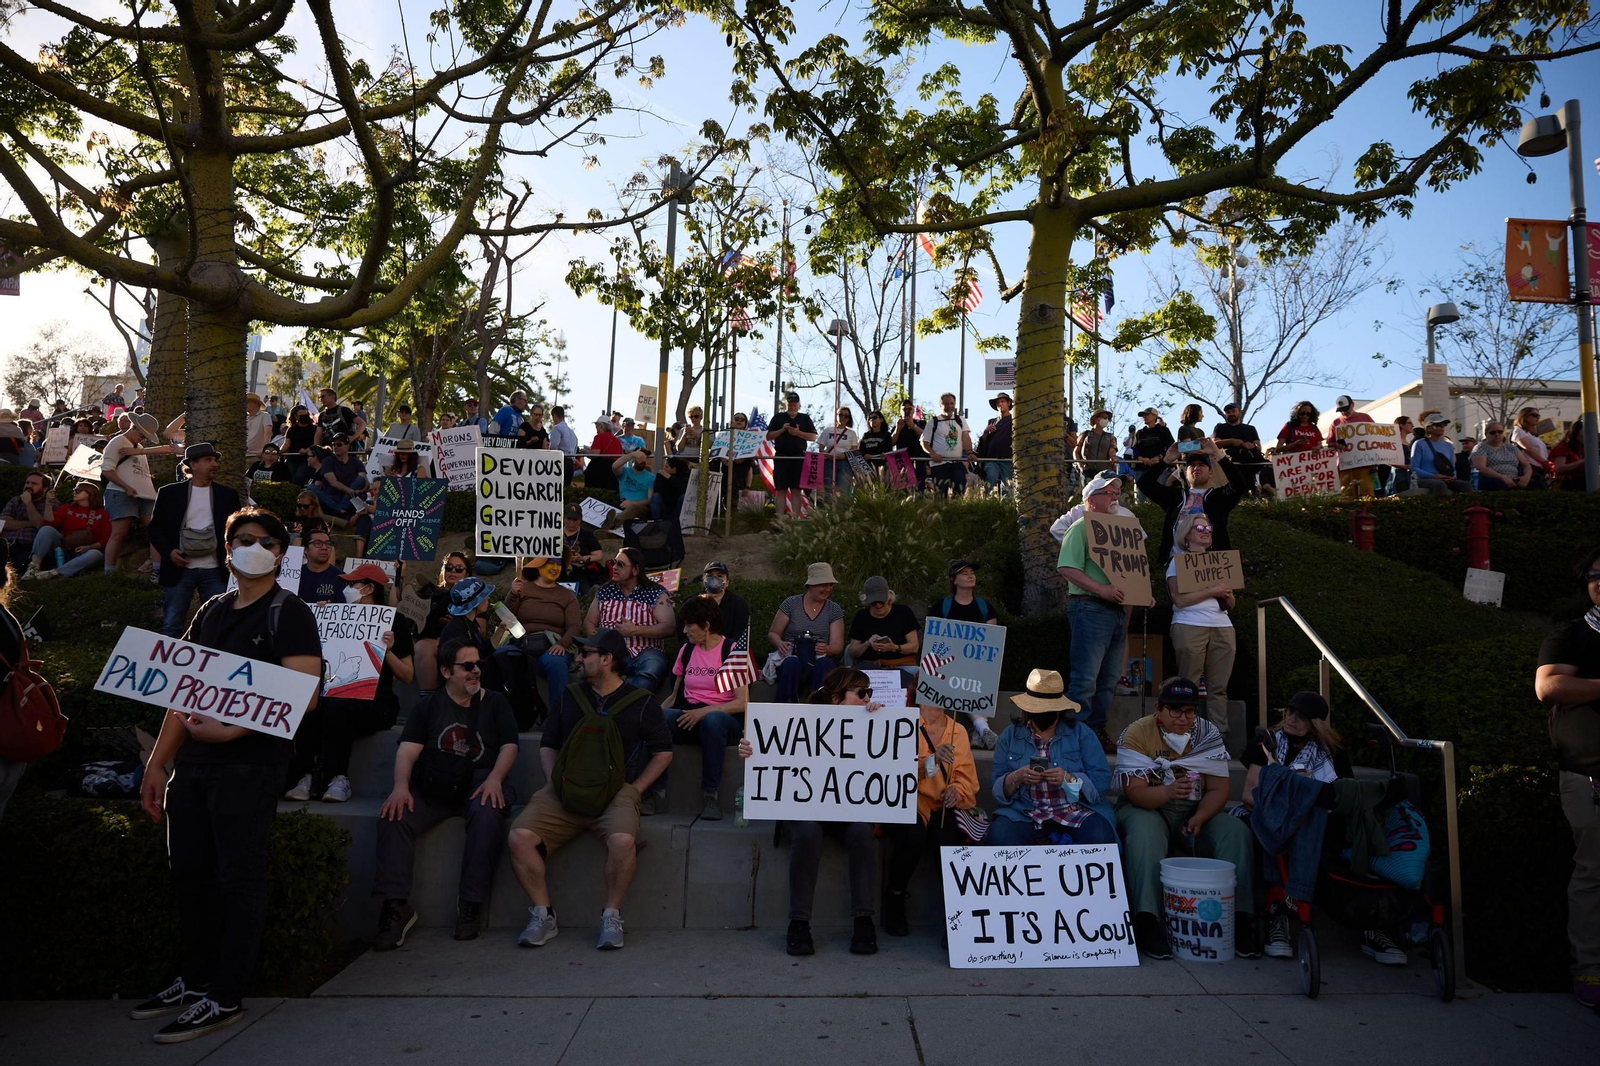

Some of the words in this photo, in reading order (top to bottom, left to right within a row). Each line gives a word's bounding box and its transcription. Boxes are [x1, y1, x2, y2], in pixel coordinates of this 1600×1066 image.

[432, 431, 473, 446] MORONS
[1337, 424, 1355, 439] NO
[1356, 423, 1396, 437] CROWNS
[482, 437, 496, 448] HEY
[495, 437, 519, 449] DIDN'T
[1357, 440, 1397, 451] CLOWNS
[437, 446, 455, 460] ARE
[1277, 455, 1293, 466] MY
[439, 458, 476, 472] GOVERNIN
[481, 453, 562, 477] DEVIOUS
[1279, 466, 1303, 479] ARE
[1305, 460, 1329, 473] NOT
[443, 471, 476, 483] AMERICA
[1290, 475, 1306, 485] UP
[481, 478, 562, 502] OLIGARCH
[378, 494, 391, 507] NATO
[391, 509, 425, 519] HANDS
[480, 505, 562, 530] GRIFTING
[481, 531, 562, 557] EVERYONE
[1091, 520, 1143, 550] DUMP
[1092, 547, 1147, 577] TRUMP
[1185, 552, 1229, 569] PUTIN'S
[1194, 565, 1233, 583] PUPPET
[341, 605, 357, 621] BE
[357, 606, 369, 621] A
[370, 607, 392, 625] PIG
[325, 622, 380, 640] FASCIST!
[927, 620, 986, 642] HANDS
[963, 643, 999, 662] OFF
[150, 640, 220, 672] NOT
[227, 660, 253, 686] A
[101, 655, 168, 696] PAID
[170, 675, 292, 733] PROTESTER
[949, 676, 982, 693] OUR
[917, 681, 994, 712] DEMOCRACY
[753, 718, 856, 759] WAKE
[868, 718, 919, 761] UP!
[751, 766, 813, 802] IT'S
[820, 767, 841, 804] A
[846, 771, 917, 808] COUP
[950, 861, 1045, 897] WAKE
[1059, 862, 1114, 899] UP!
[972, 909, 1042, 944] IT'S
[1054, 909, 1075, 944] A
[1071, 952, 1080, 960] is
